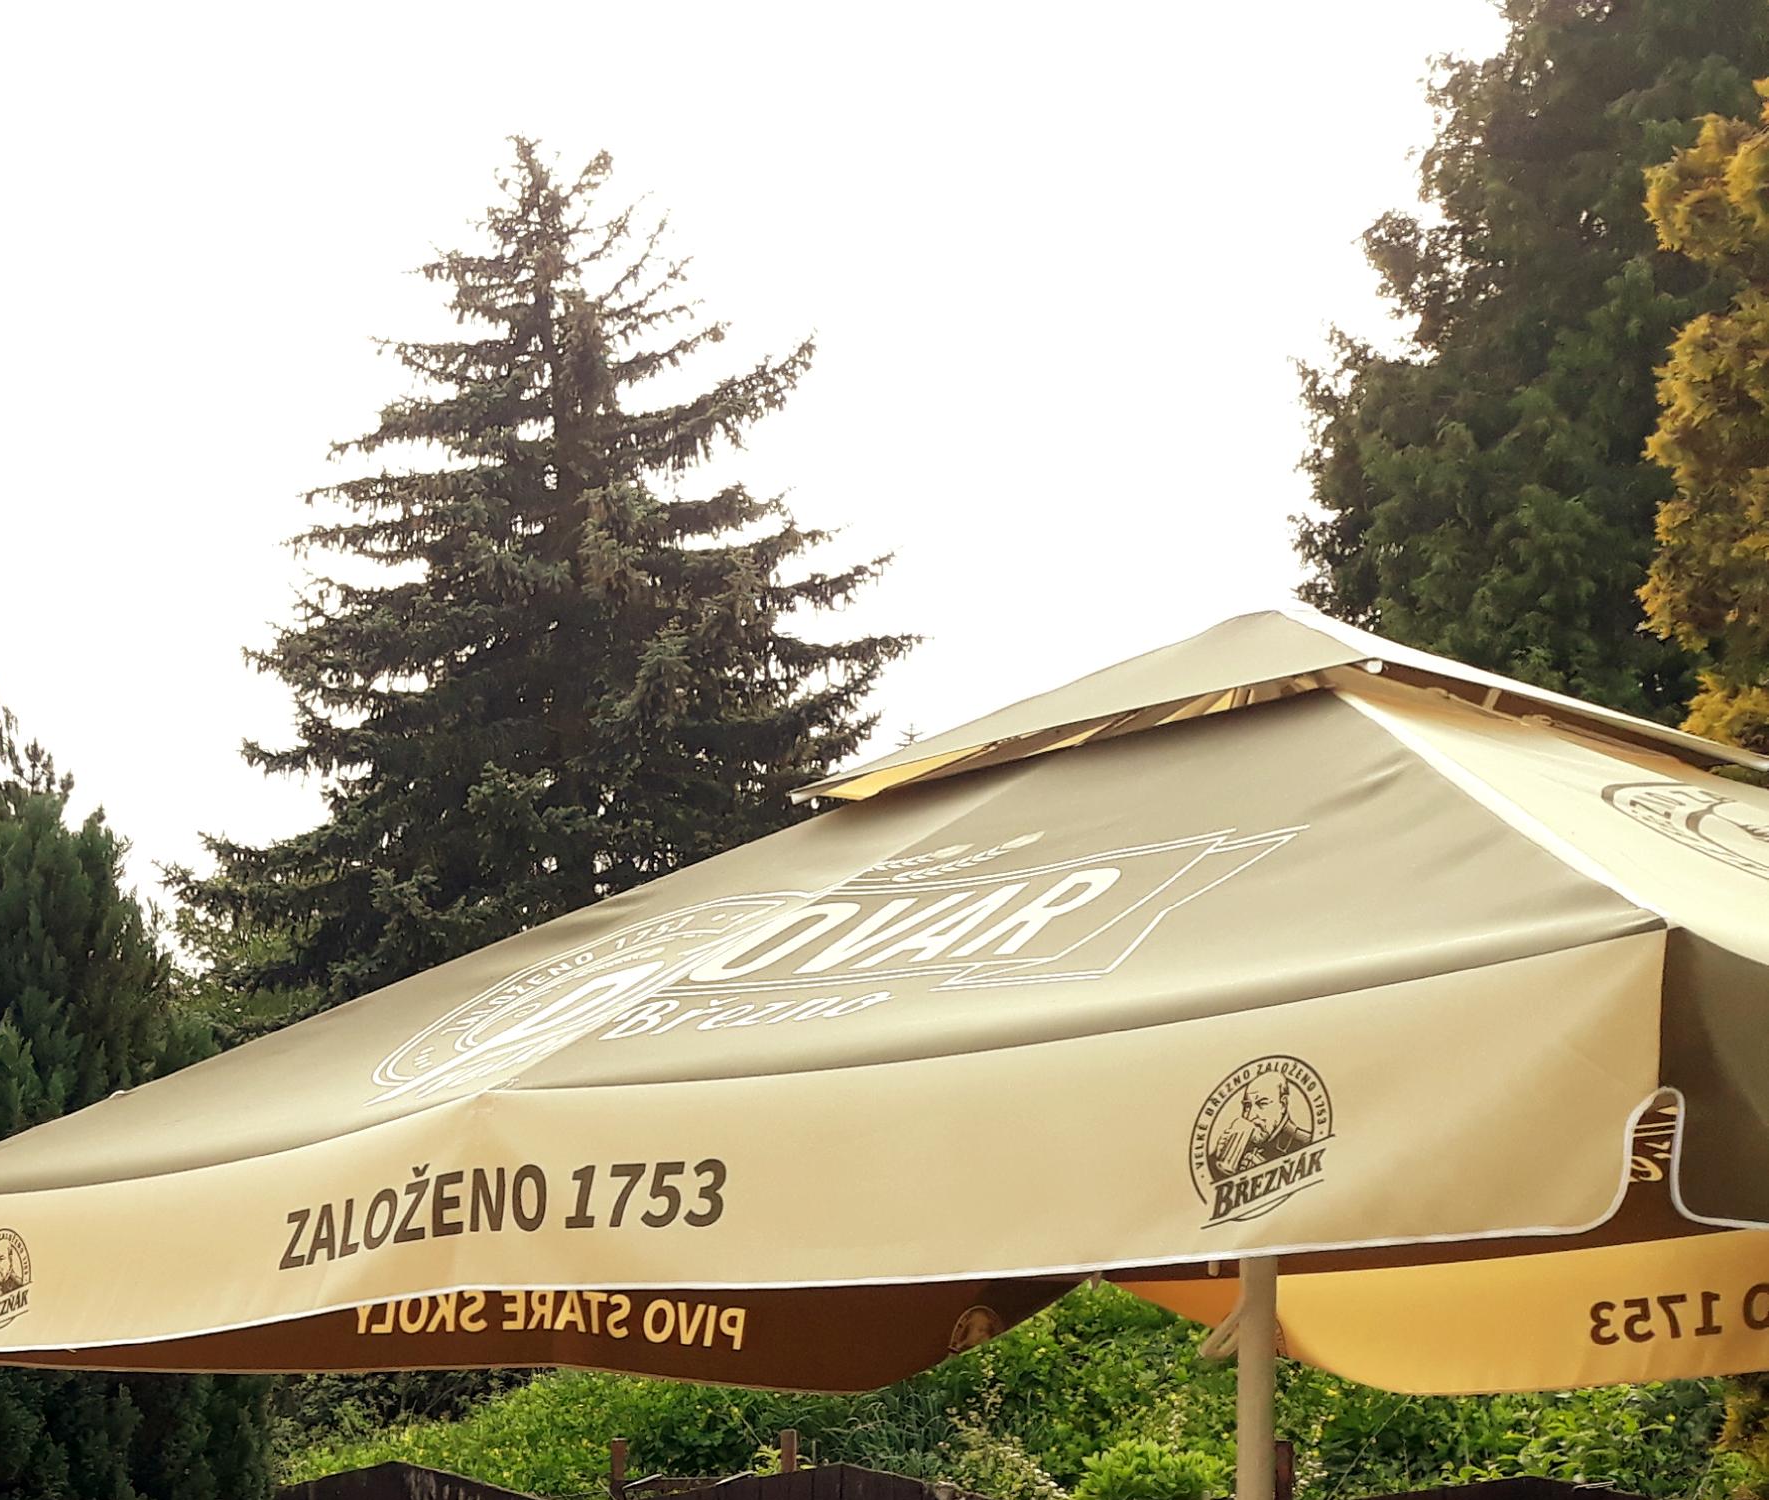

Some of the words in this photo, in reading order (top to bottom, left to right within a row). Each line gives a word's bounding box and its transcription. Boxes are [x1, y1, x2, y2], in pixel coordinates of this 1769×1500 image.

[597, 990, 896, 1041] Březno
[1193, 1123, 1209, 1170] VELKÉ
[1257, 1061, 1317, 1092] ZALOŽENO
[1313, 1094, 1328, 1126] 1753
[278, 1162, 548, 1271] ZALOŽENO
[564, 1157, 728, 1230] 1753
[1208, 1148, 1327, 1222] BŘEZŇÁK
